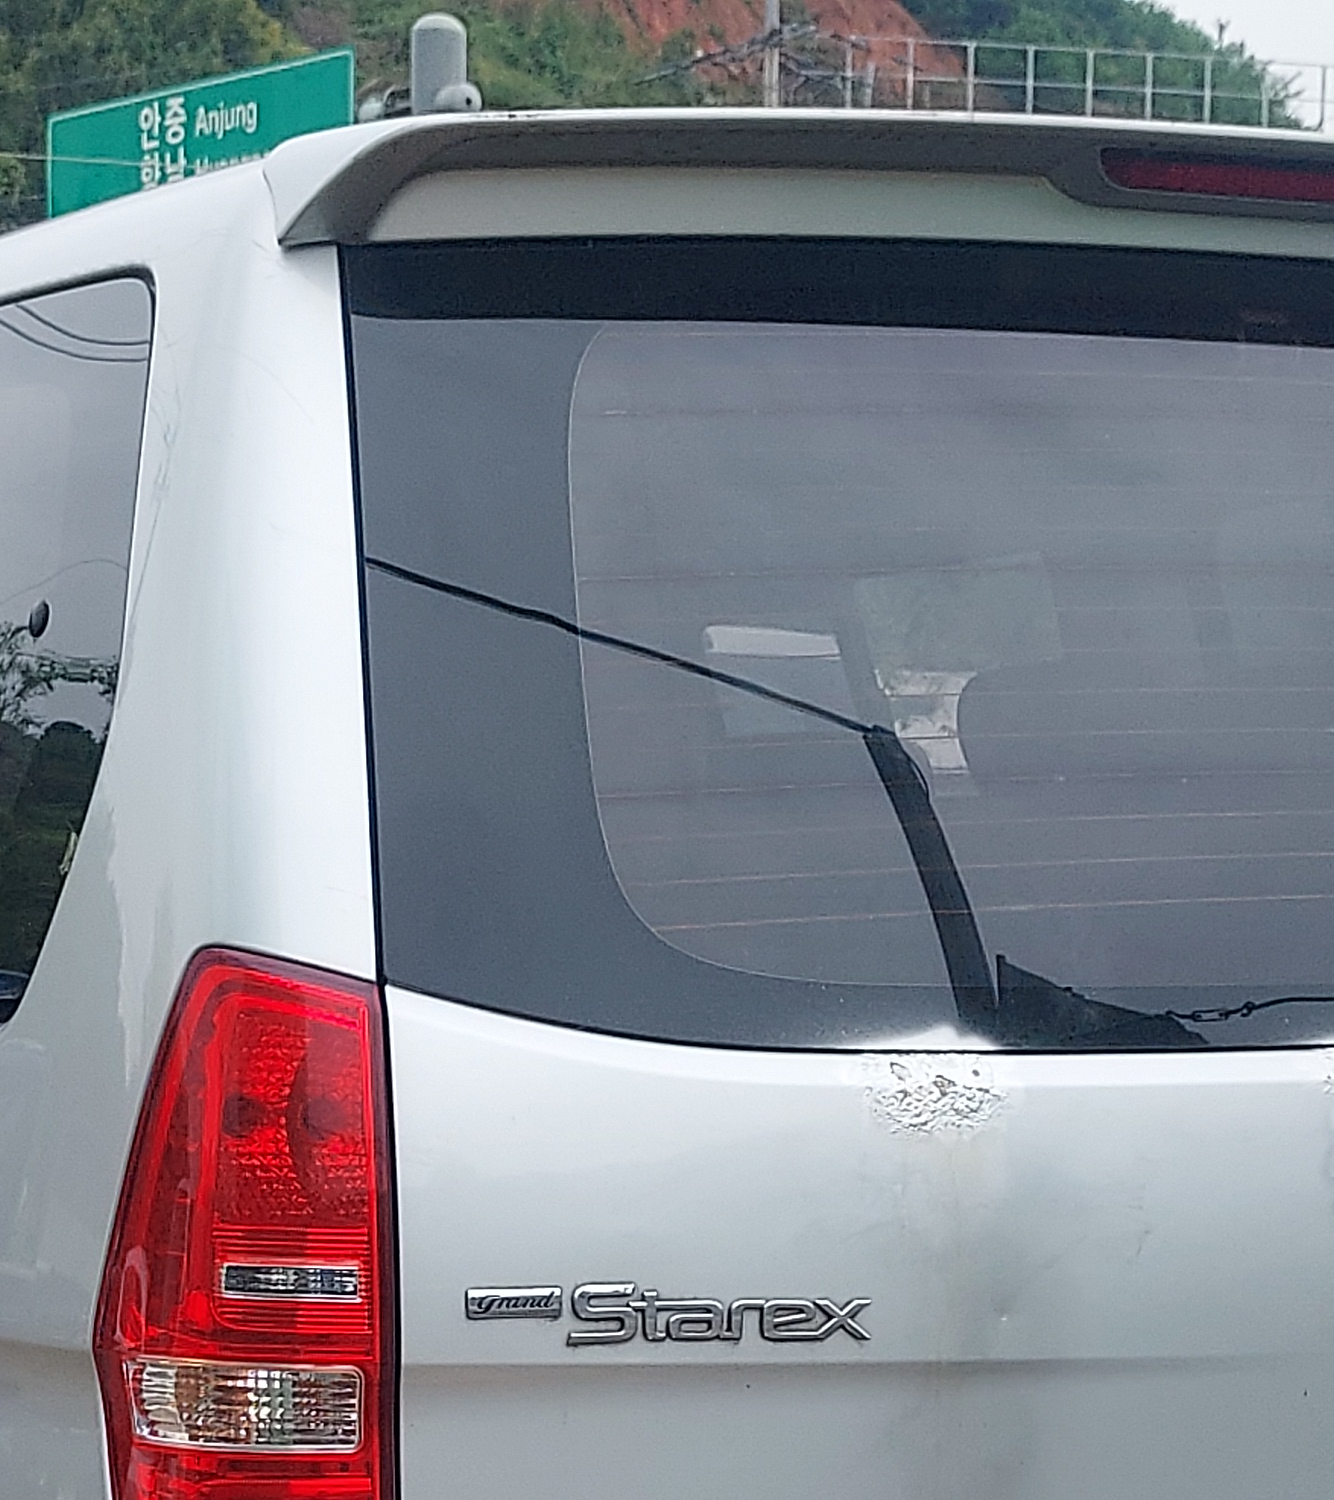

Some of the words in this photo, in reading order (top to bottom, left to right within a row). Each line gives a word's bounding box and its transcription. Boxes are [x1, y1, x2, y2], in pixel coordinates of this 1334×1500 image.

[138, 95, 187, 151] 안중
[194, 101, 258, 140] Anjung
[566, 1282, 872, 1346] Starex
